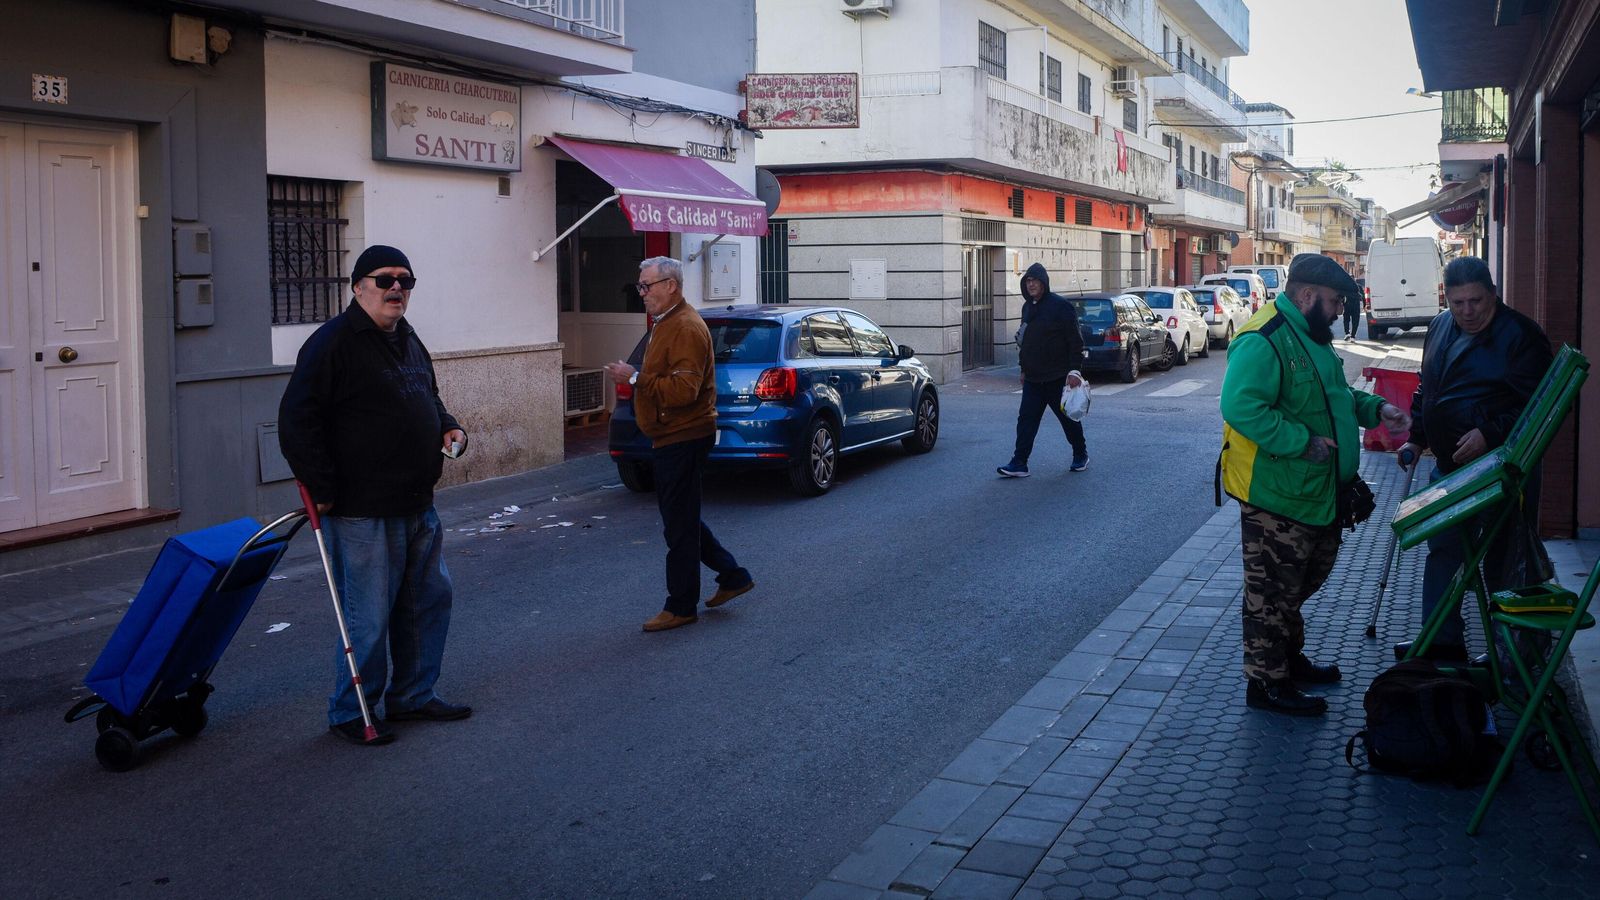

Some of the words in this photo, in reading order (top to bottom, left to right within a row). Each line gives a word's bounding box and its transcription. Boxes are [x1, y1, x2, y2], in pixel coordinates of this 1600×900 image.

[39, 80, 61, 98] 35
[389, 70, 450, 93] CARNICERIA
[453, 81, 518, 104] CHARCUTERIA
[426, 105, 448, 120] Solo
[450, 110, 486, 126] Calidad
[415, 133, 497, 164] SANTI
[629, 203, 662, 224] Sólo
[667, 206, 717, 227] Calidad
